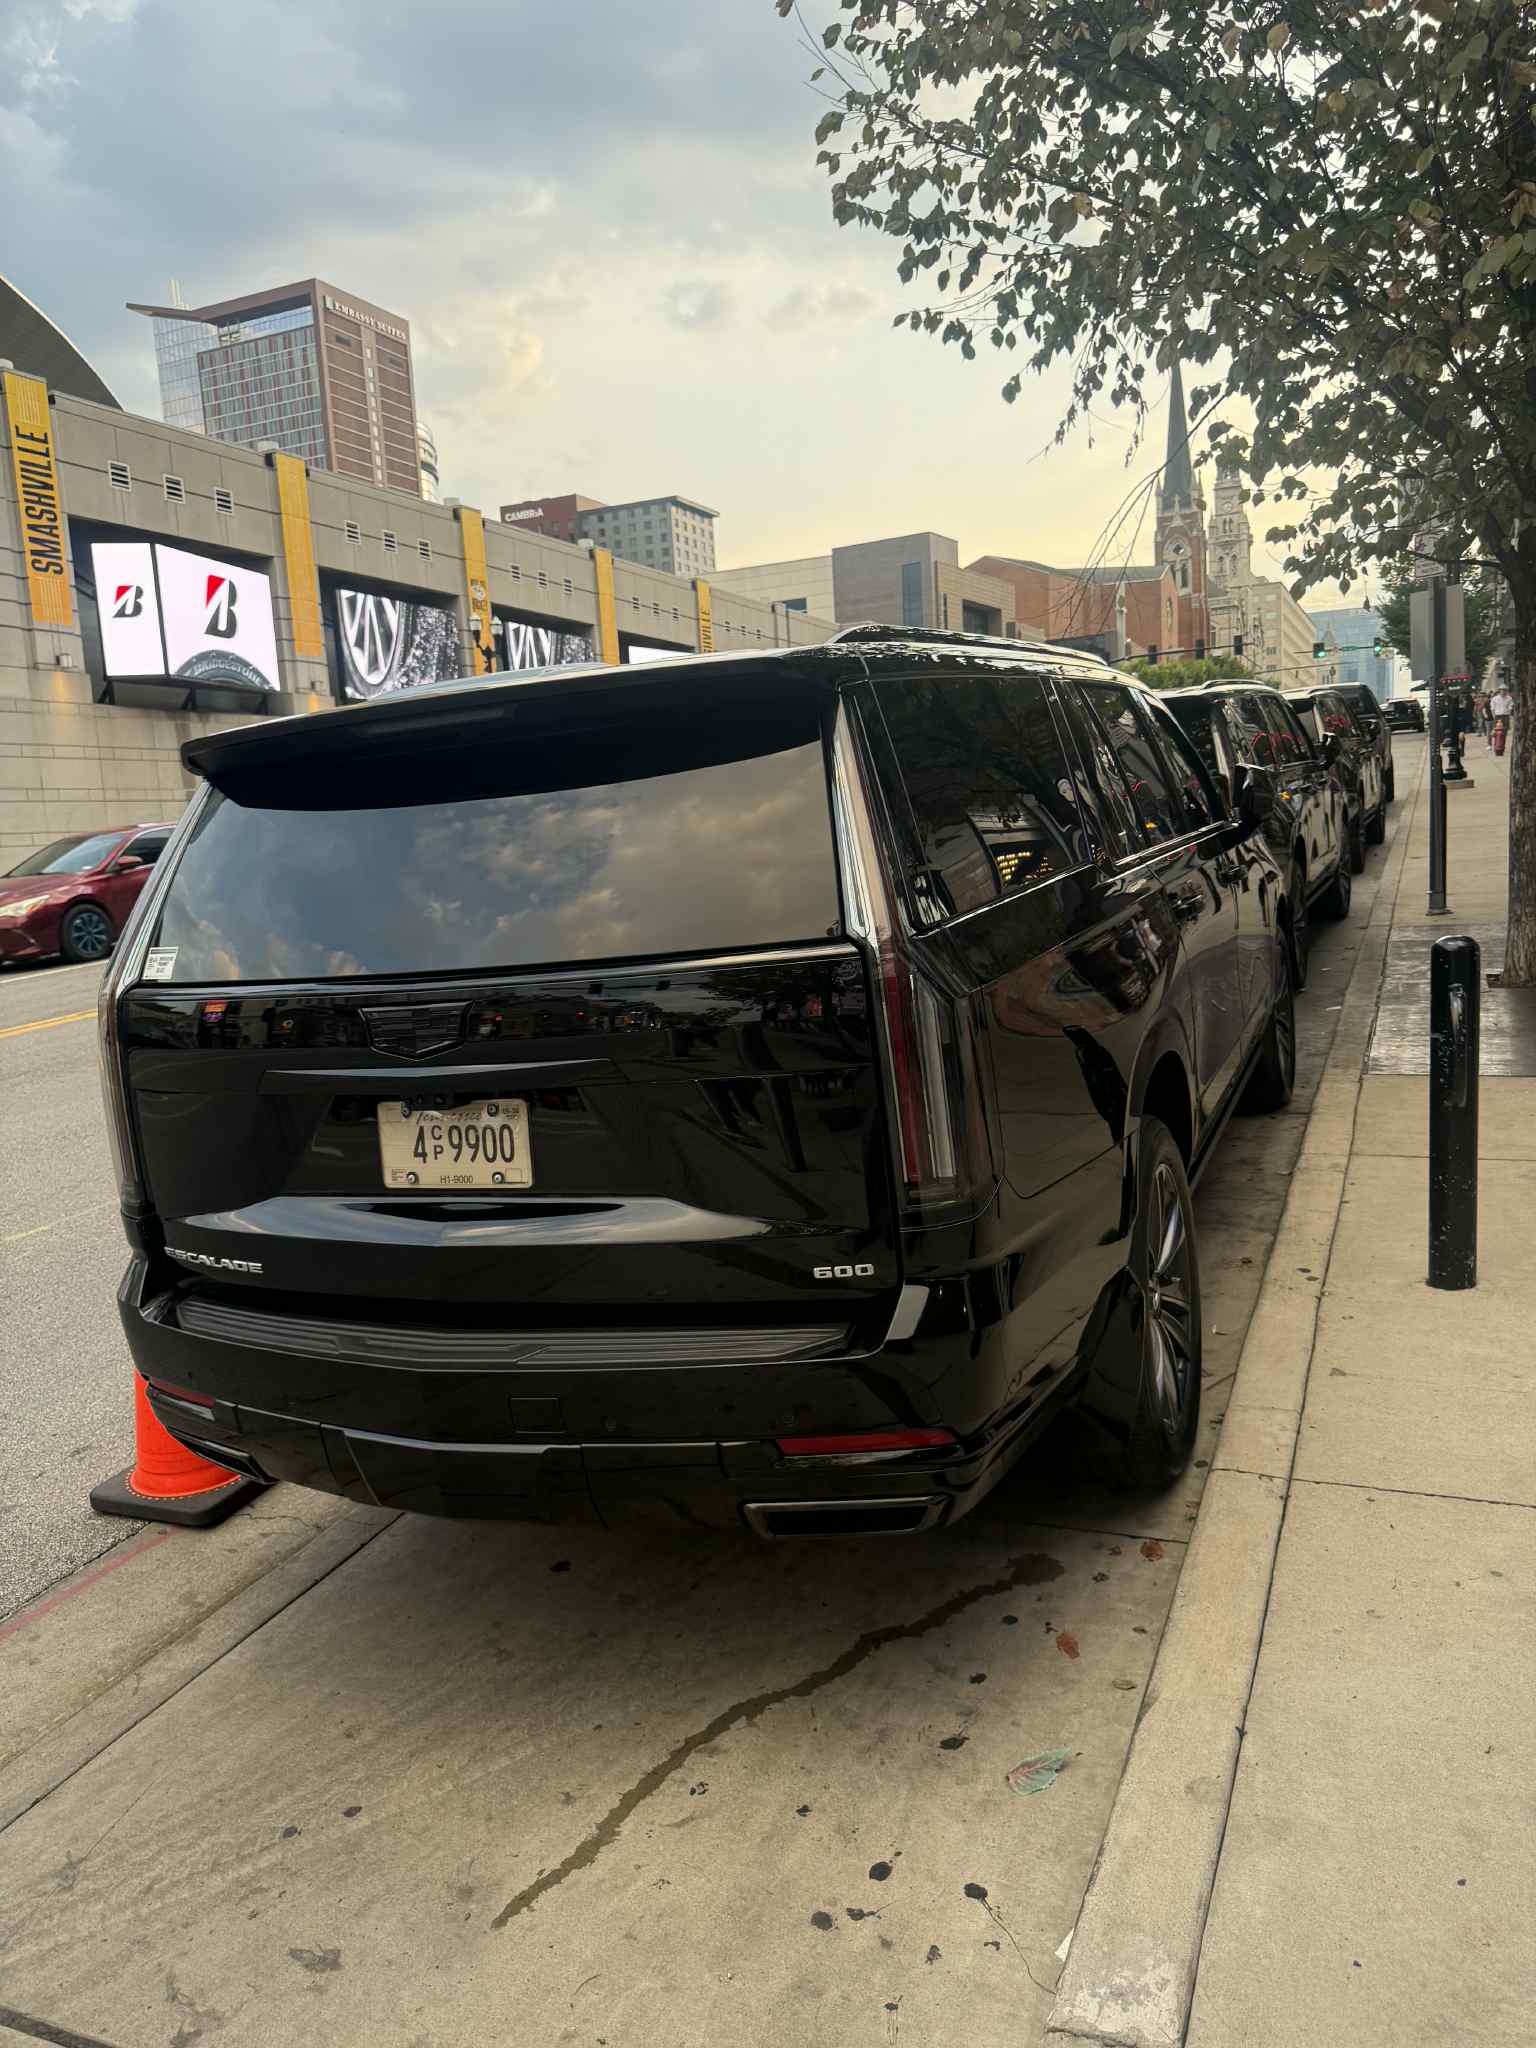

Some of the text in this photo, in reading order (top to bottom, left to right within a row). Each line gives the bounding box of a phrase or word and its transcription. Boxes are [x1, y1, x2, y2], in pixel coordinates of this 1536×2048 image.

[335, 302, 407, 340] EMBASSY SUITES
[15, 424, 65, 576] SMASHVILLE
[505, 508, 545, 522] CAMBRIA
[163, 1246, 264, 1274] ESCALADE
[813, 1263, 875, 1279] 600
